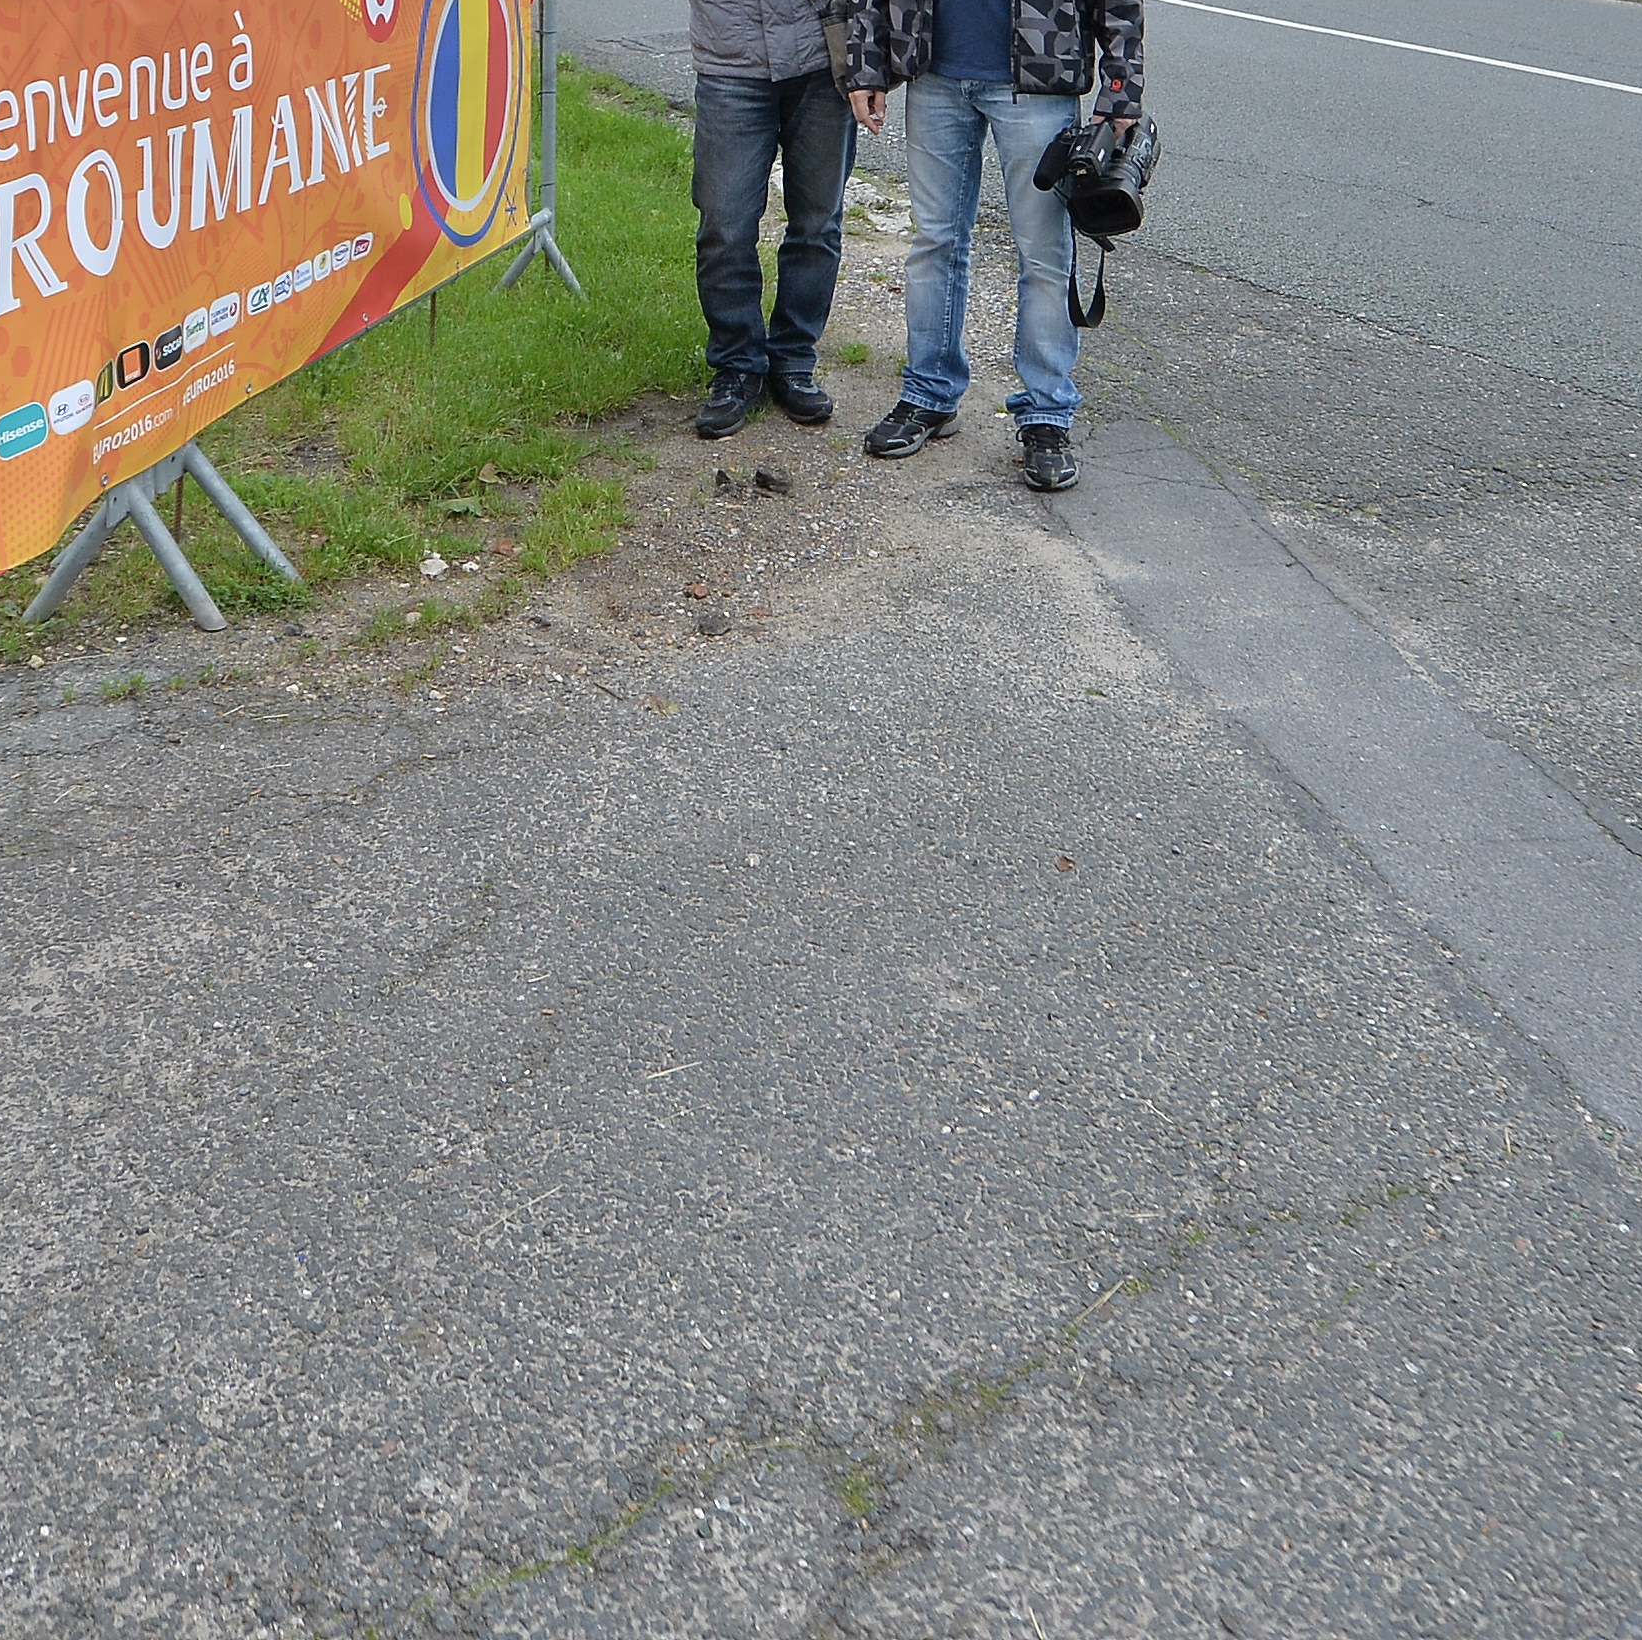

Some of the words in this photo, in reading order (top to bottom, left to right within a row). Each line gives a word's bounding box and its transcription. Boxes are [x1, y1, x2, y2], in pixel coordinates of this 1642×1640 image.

[228, 10, 254, 92] à
[162, 335, 183, 357] SOCA
[92, 407, 173, 465] EURO2016.com
